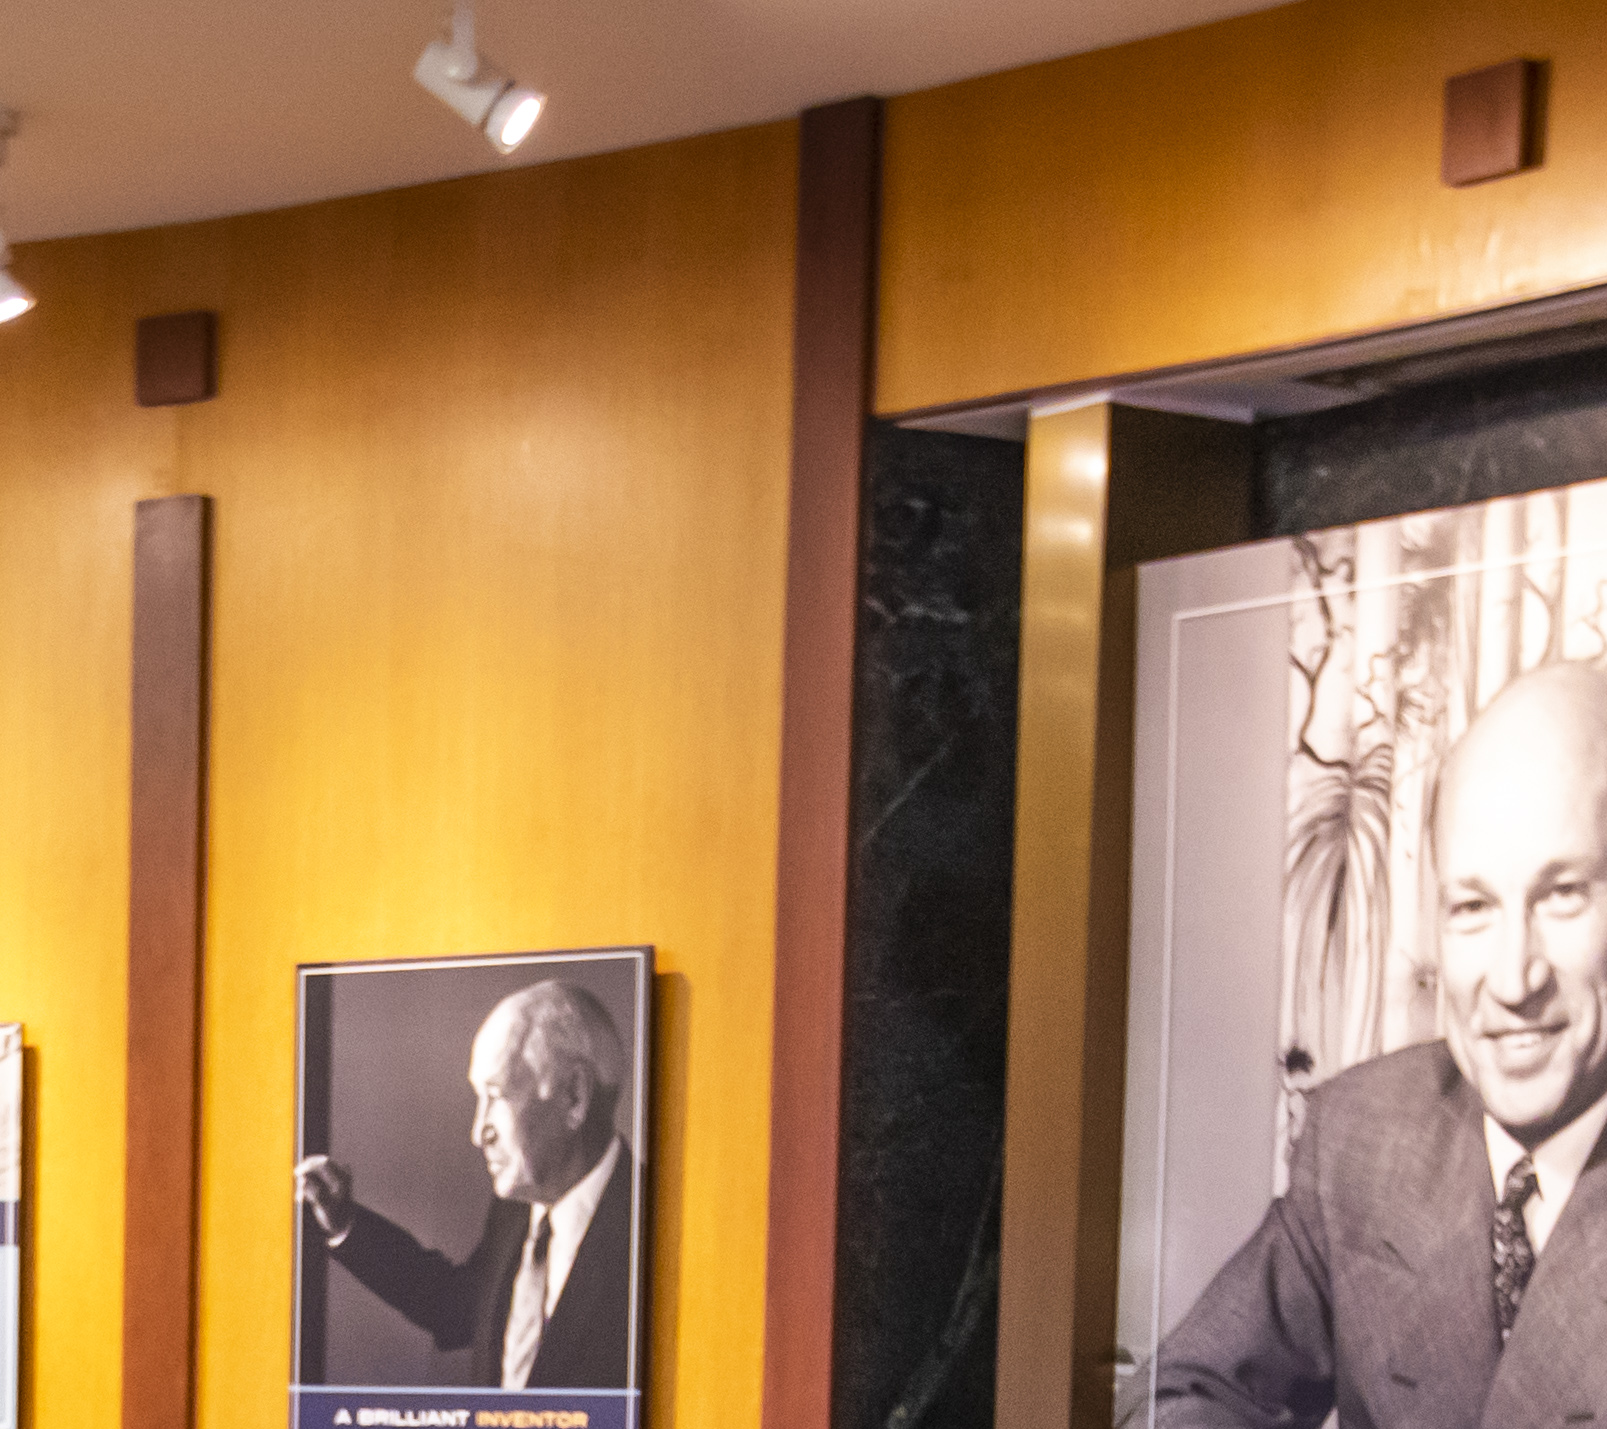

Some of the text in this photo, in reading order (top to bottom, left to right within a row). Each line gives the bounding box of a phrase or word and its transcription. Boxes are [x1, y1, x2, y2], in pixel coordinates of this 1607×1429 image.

[333, 1408, 589, 1429] A BRILLIANT INVENTOR
